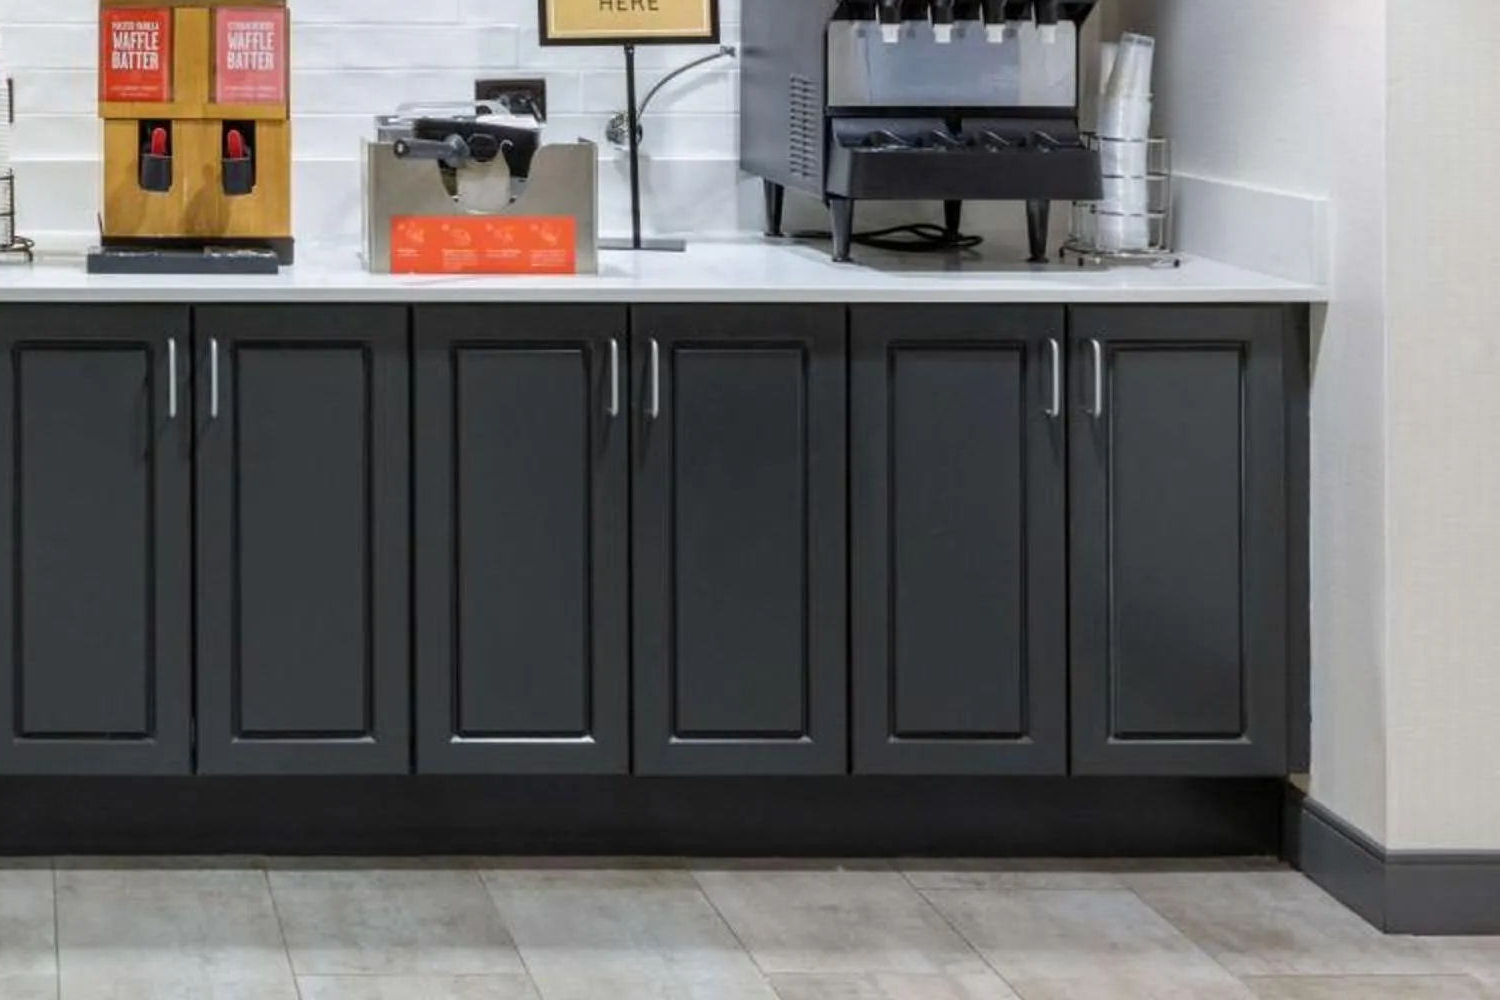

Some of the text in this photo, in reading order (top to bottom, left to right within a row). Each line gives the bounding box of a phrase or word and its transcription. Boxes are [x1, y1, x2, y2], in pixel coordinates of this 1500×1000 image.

[112, 31, 159, 50] WAFFLE
[227, 31, 275, 51] WAFFLE
[112, 51, 159, 70] BATTER
[227, 51, 275, 70] BATTER
